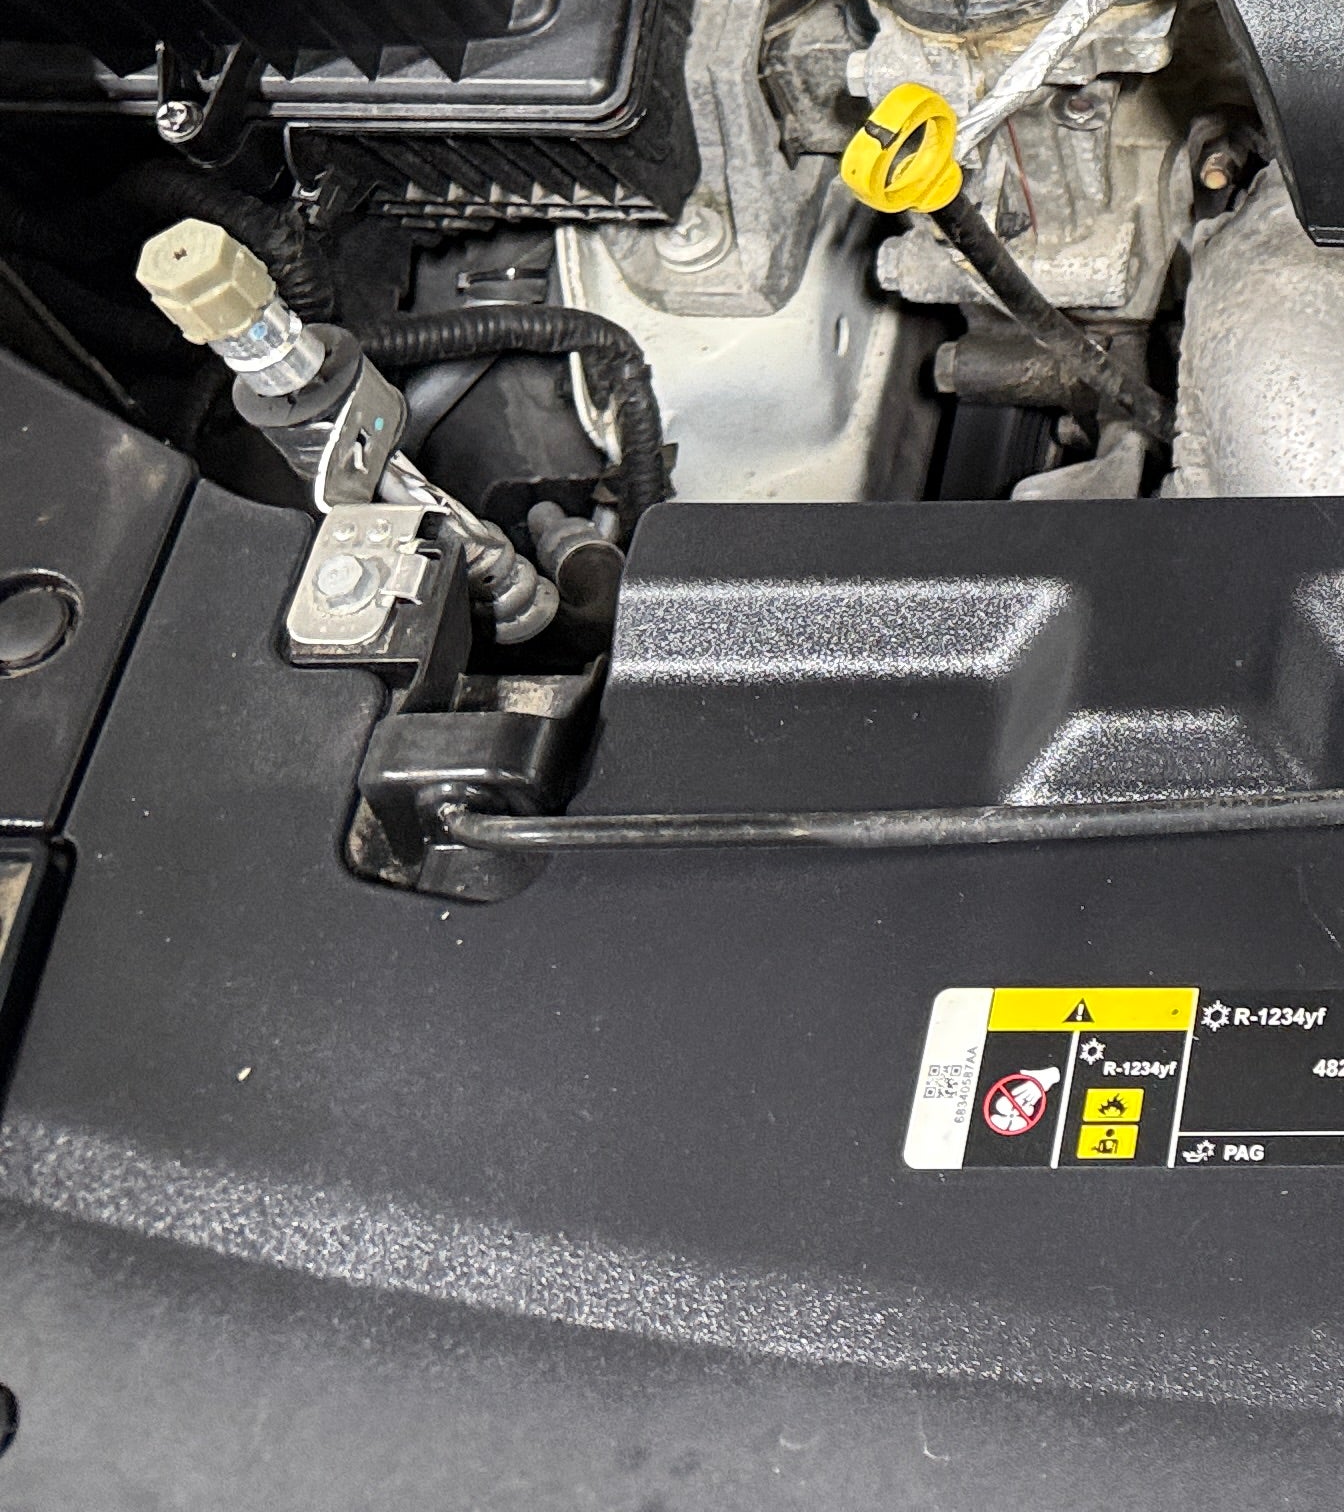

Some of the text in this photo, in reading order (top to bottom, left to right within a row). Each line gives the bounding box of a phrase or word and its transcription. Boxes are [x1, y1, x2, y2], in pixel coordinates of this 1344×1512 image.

[1233, 1006, 1327, 1031] R-1234yf
[1102, 1060, 1177, 1079] R-1234yf
[1223, 1144, 1265, 1162] PAG
